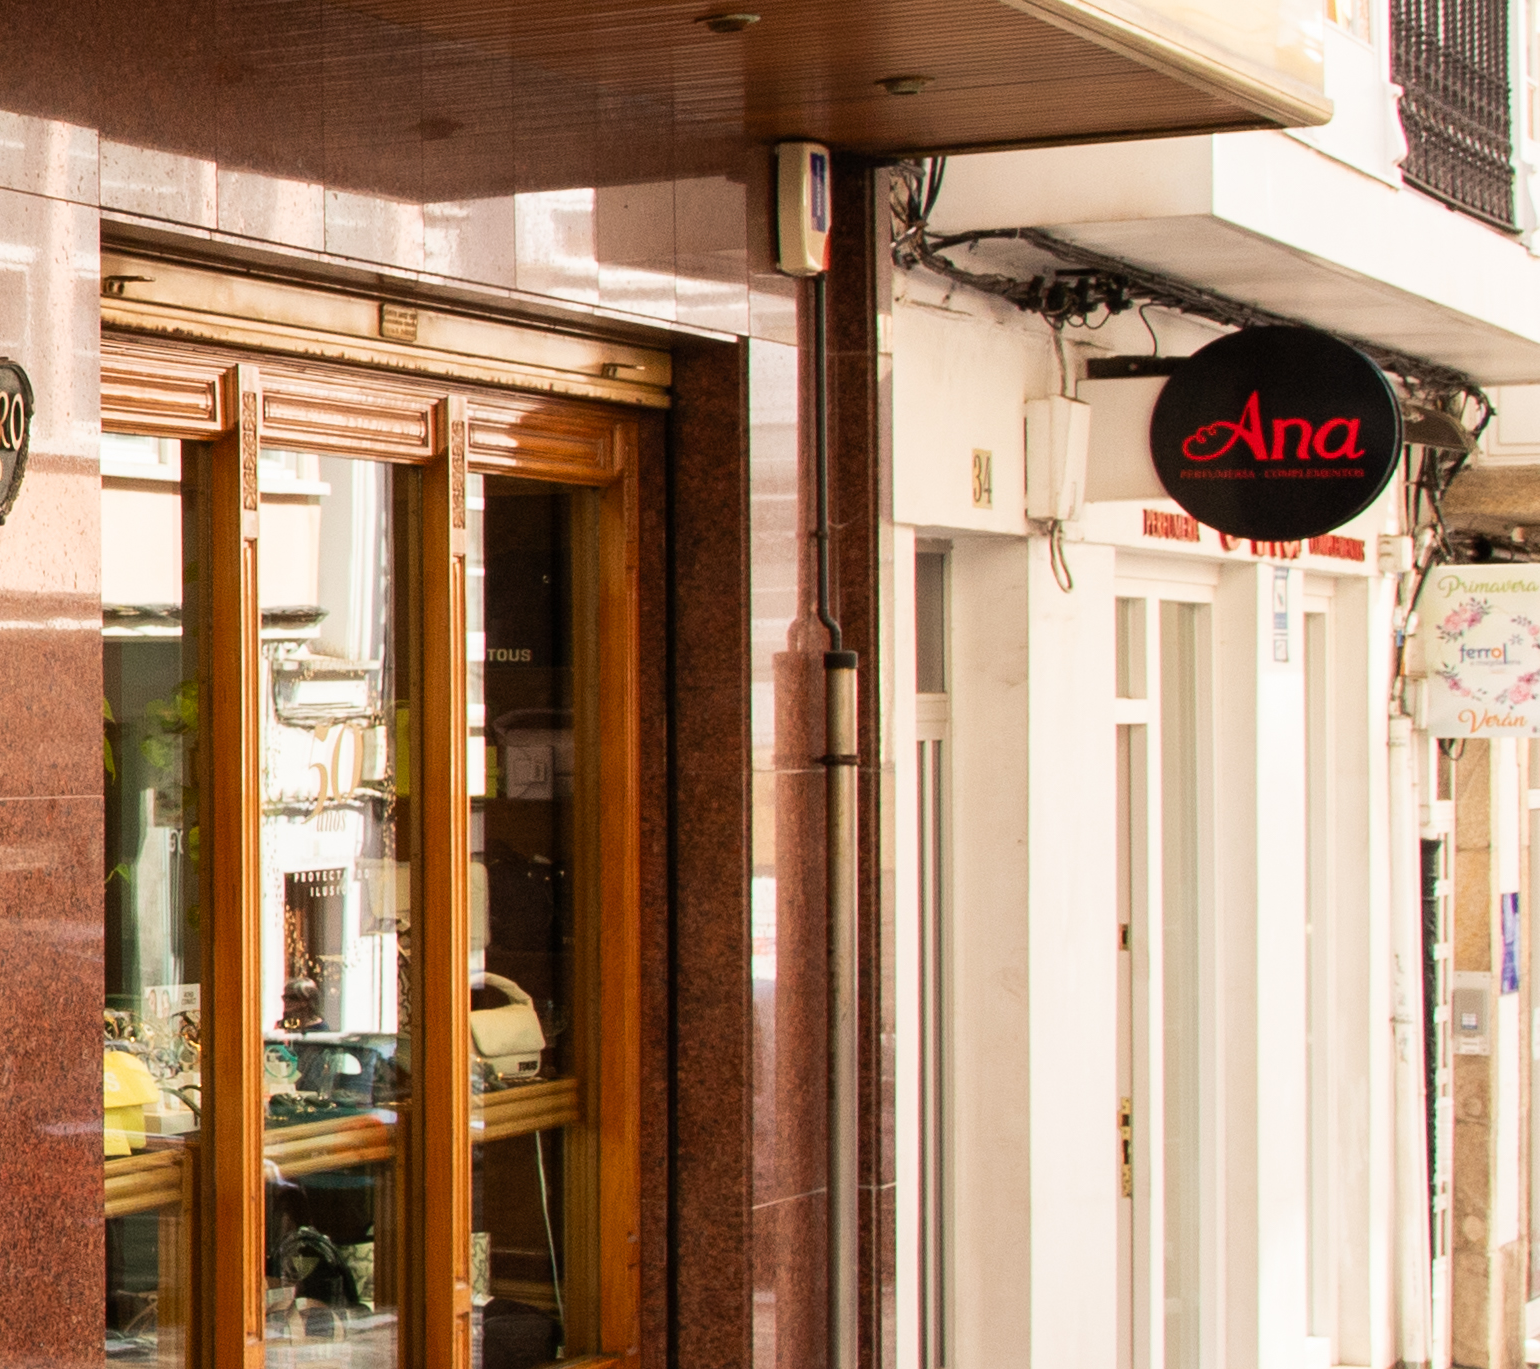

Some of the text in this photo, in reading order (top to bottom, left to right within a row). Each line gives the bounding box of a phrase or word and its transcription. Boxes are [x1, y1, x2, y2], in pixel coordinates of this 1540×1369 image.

[1181, 390, 1365, 461] Ana
[972, 453, 993, 505] 34
[1438, 574, 1540, 599] Primavera
[487, 649, 532, 662] TOUS
[1460, 643, 1507, 664] ferrol
[1458, 709, 1526, 734] Verán
[302, 722, 364, 825] 50
